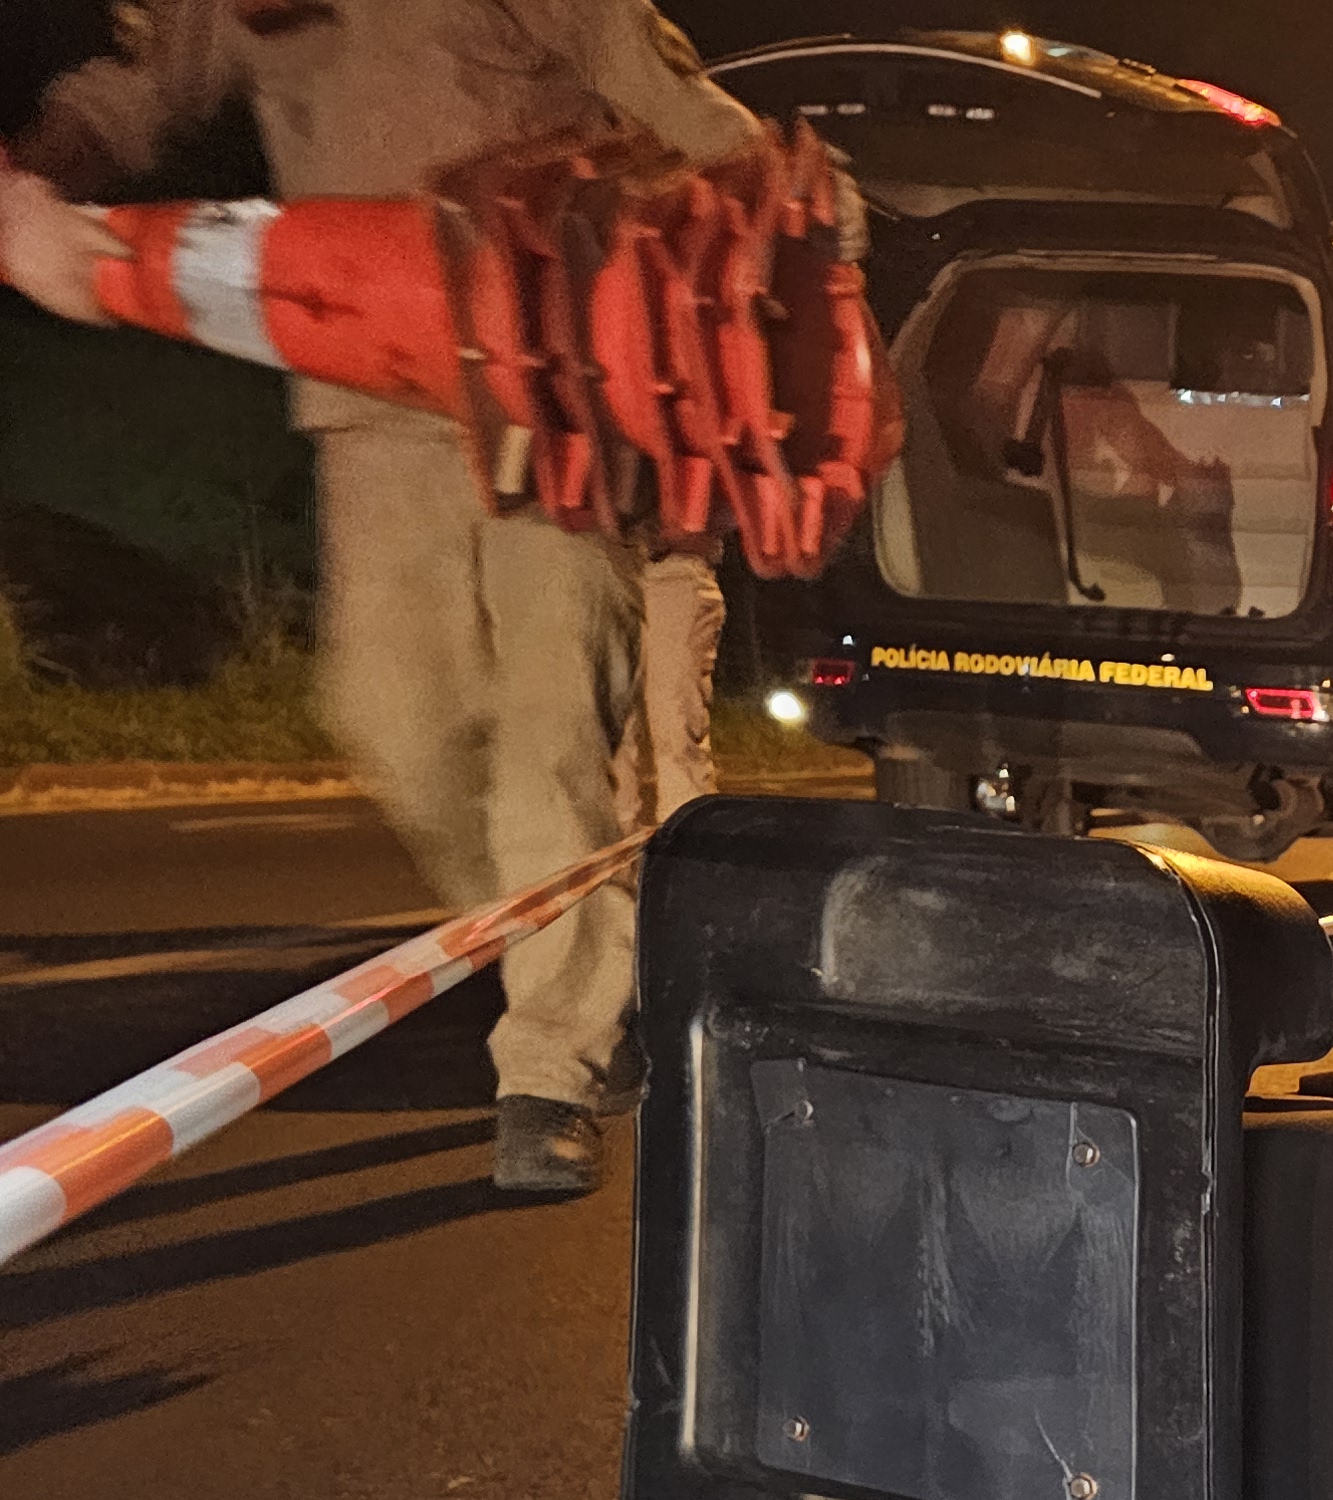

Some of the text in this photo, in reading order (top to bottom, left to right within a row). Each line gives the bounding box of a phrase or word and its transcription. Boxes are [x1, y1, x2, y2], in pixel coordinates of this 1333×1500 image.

[871, 643, 1214, 691] POLÍCIA RODOVIÁRIA FEDERAL
